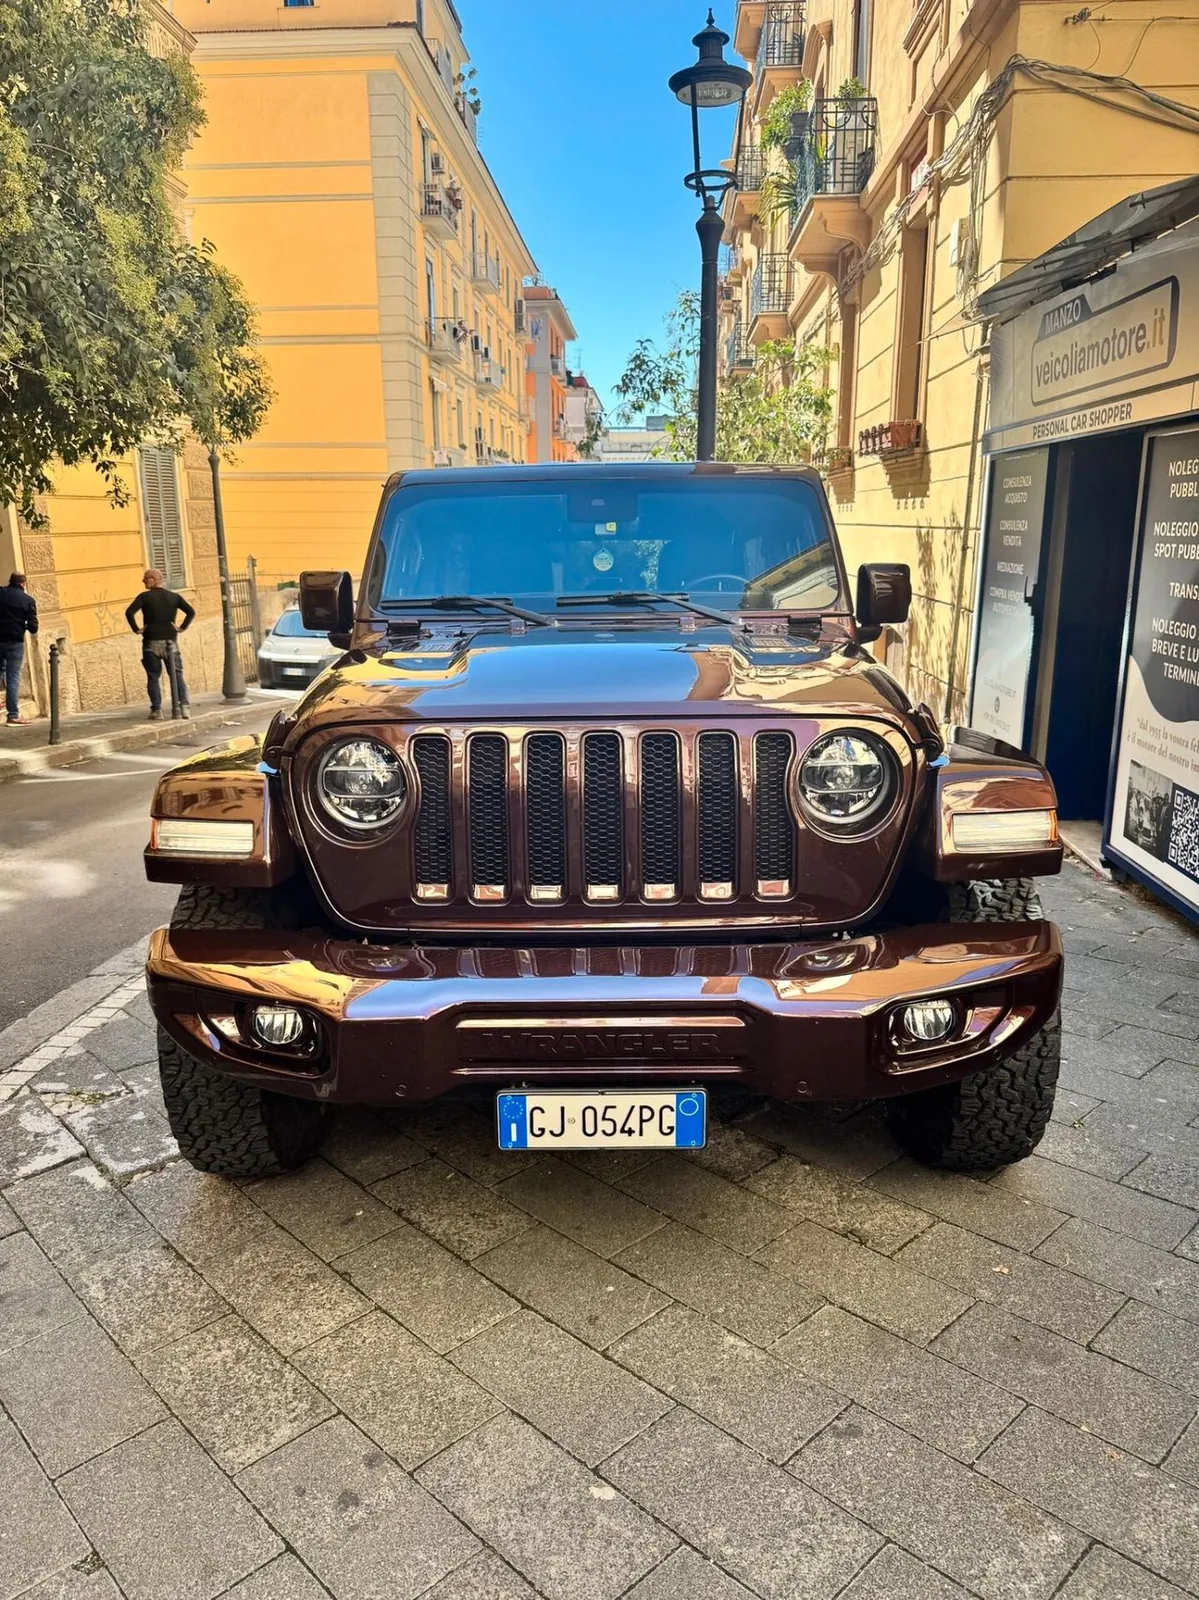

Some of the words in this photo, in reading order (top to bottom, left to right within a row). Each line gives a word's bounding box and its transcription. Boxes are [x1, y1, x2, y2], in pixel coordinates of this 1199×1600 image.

[1045, 299, 1081, 334] MANZO
[1036, 308, 1166, 387] veicoliamotore.it
[1032, 419, 1069, 439] PERSONAL
[1070, 414, 1088, 432] CAR
[1089, 402, 1133, 427] SHOPPER
[1168, 459, 1199, 476] NOLEG
[1169, 482, 1199, 498] PUBBL
[1153, 521, 1199, 537] NOLEGGIO
[1154, 543, 1176, 558] SPOT
[1169, 582, 1199, 601] TRANS
[1152, 617, 1197, 640] NOLEGGIO
[1152, 638, 1179, 658] BREVE
[1179, 644, 1186, 660] E
[1157, 743, 1168, 758] del
[482, 1032, 722, 1055] WRANGLER
[529, 1105, 565, 1138] GJ
[581, 1104, 675, 1138] 054PG
